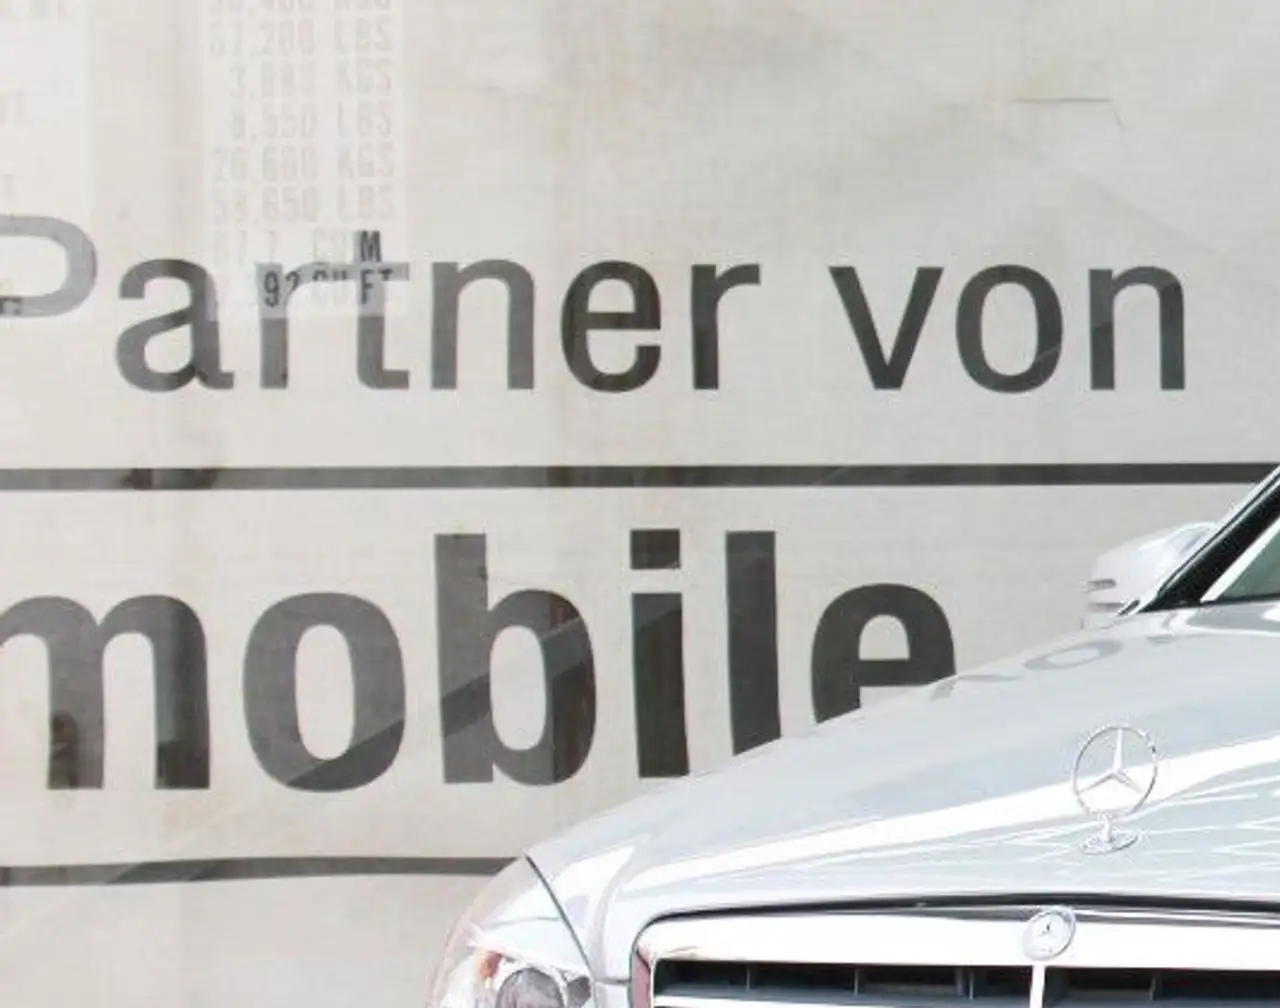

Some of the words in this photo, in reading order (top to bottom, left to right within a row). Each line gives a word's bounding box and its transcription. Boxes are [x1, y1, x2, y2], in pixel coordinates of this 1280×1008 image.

[0, 214, 760, 392] Partner
[830, 264, 1187, 393] von
[0, 528, 957, 794] mobile
